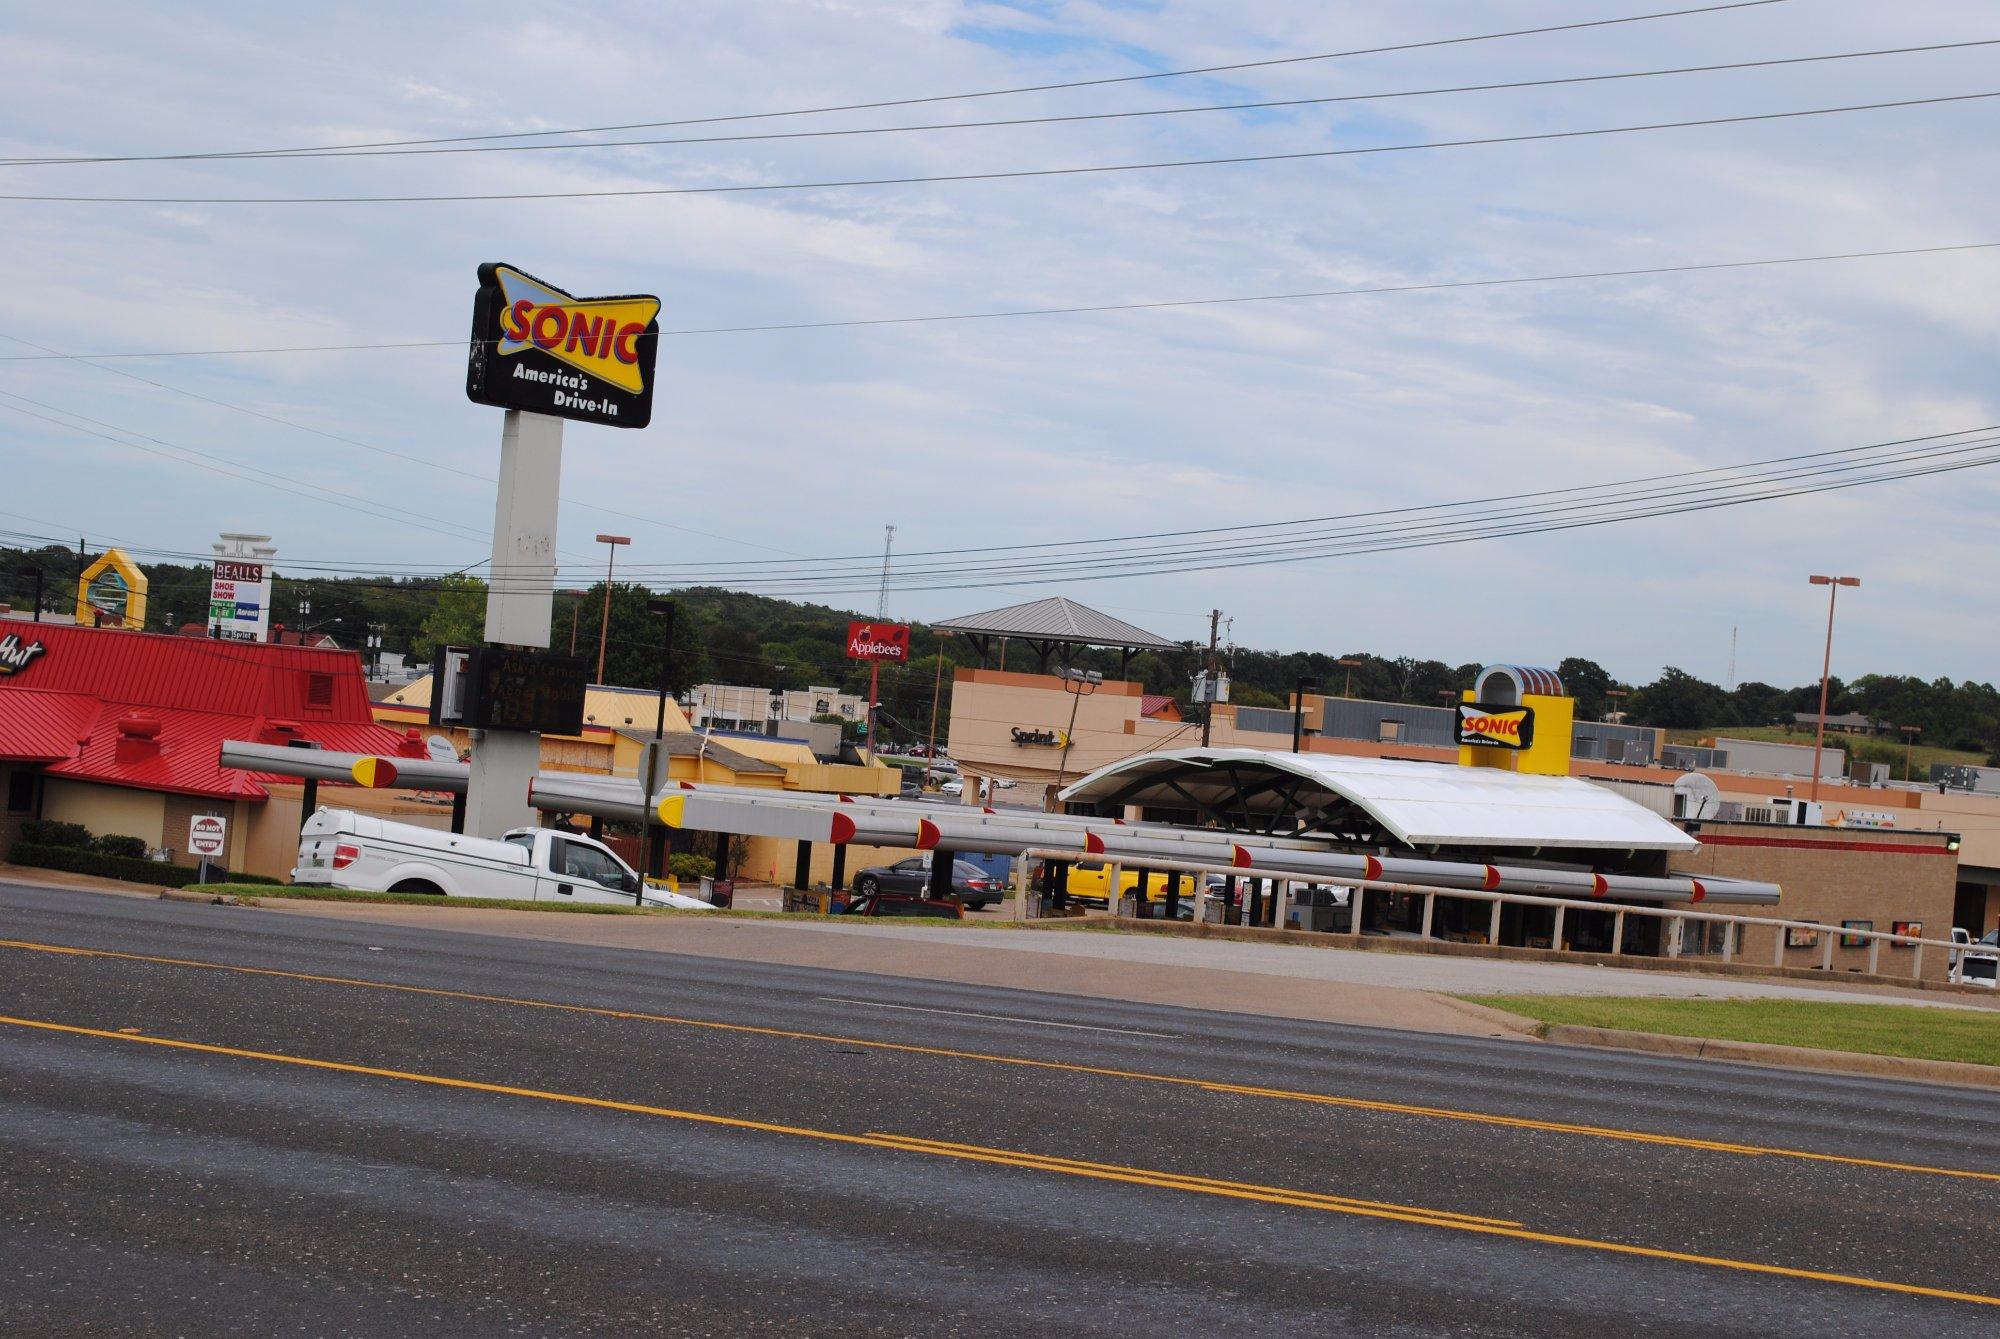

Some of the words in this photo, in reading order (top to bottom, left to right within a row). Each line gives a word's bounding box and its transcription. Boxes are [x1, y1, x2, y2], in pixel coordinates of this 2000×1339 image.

[506, 300, 646, 364] SONIC
[513, 363, 588, 391] America's
[217, 564, 260, 581] BEALLS
[214, 582, 235, 591] SHOE
[212, 591, 235, 600] SHOW
[233, 630, 251, 640] Sprint
[849, 638, 902, 656] Applebee's
[1465, 716, 1520, 735] SONIC
[1011, 726, 1055, 747] Sprint
[196, 823, 206, 831] DO
[196, 840, 217, 848] ENTER
